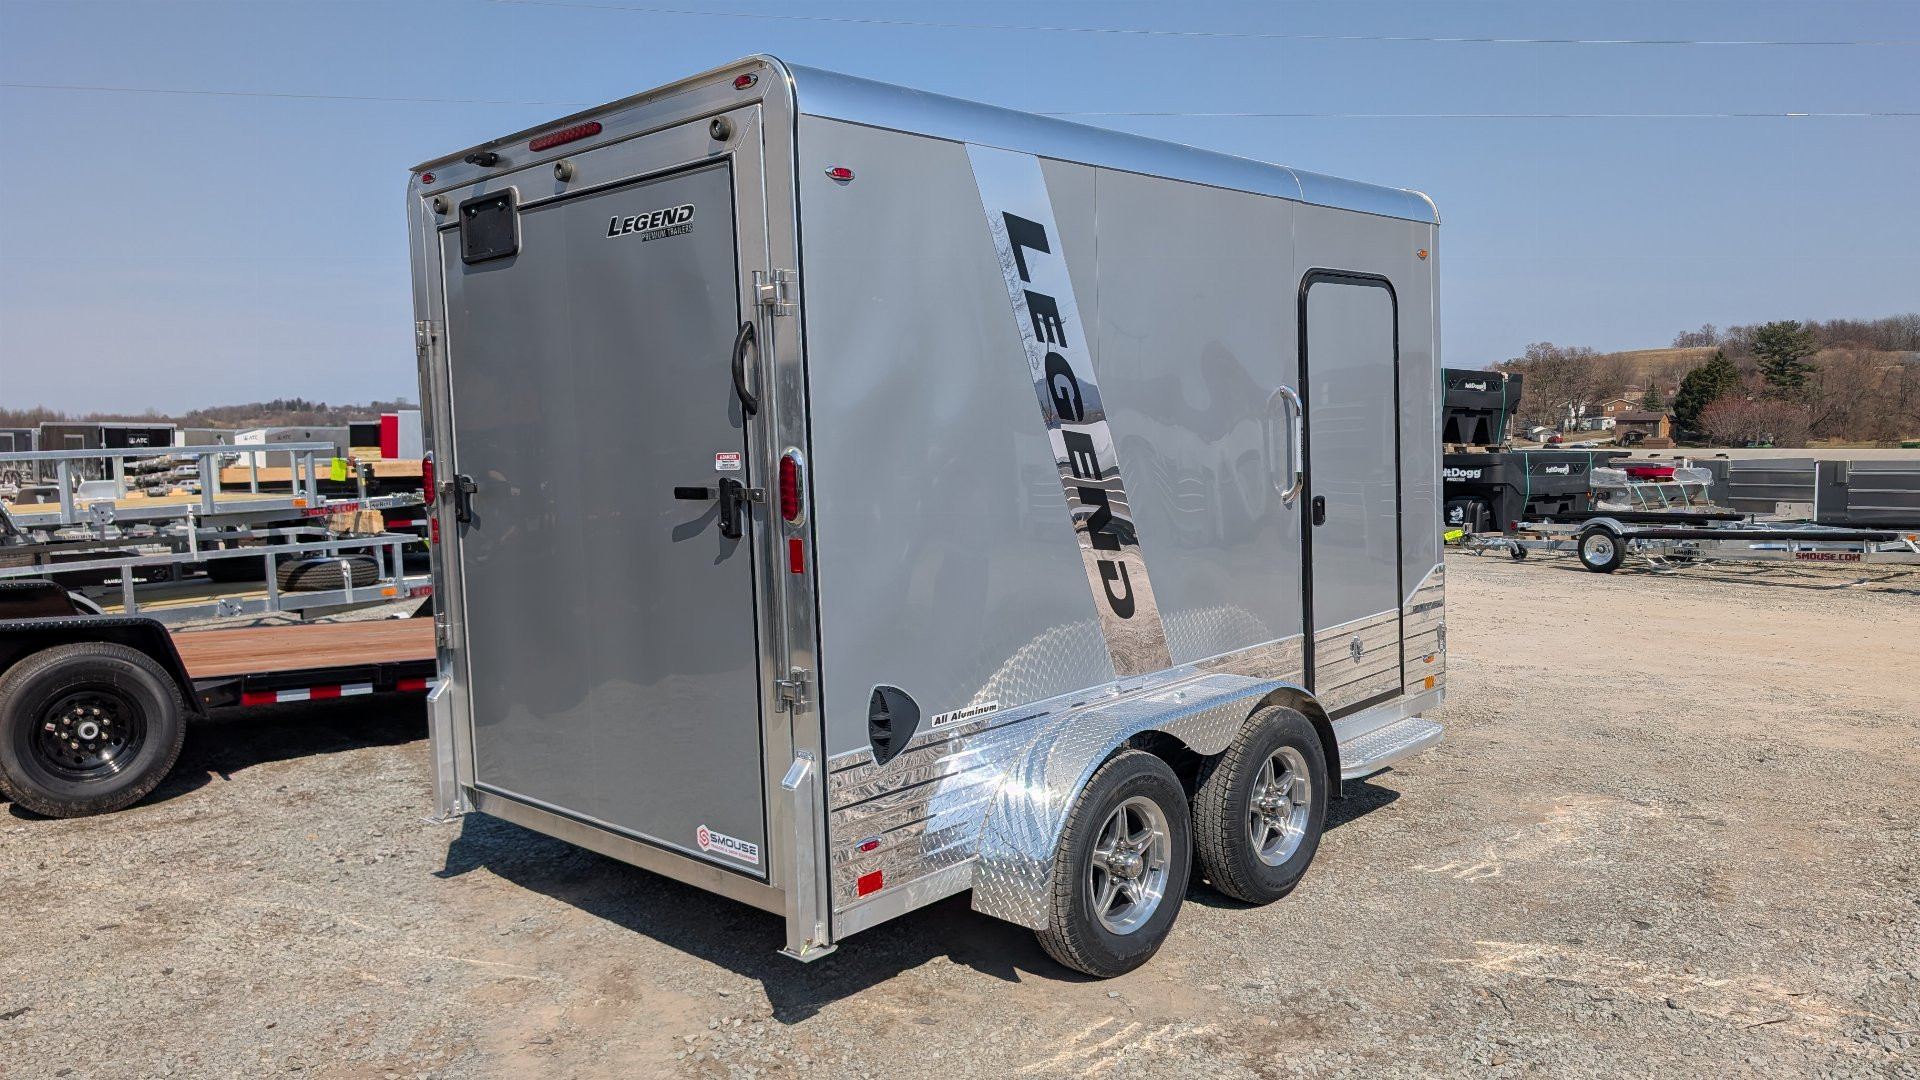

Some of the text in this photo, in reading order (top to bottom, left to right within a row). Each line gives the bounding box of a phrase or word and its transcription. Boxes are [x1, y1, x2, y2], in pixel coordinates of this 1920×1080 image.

[607, 204, 695, 237] LEGEND
[1002, 211, 1135, 620] LEGEND
[1795, 552, 1861, 562] SMOUSE.COM
[934, 705, 997, 725] All Aluminum
[710, 833, 756, 855] SMOUSE
